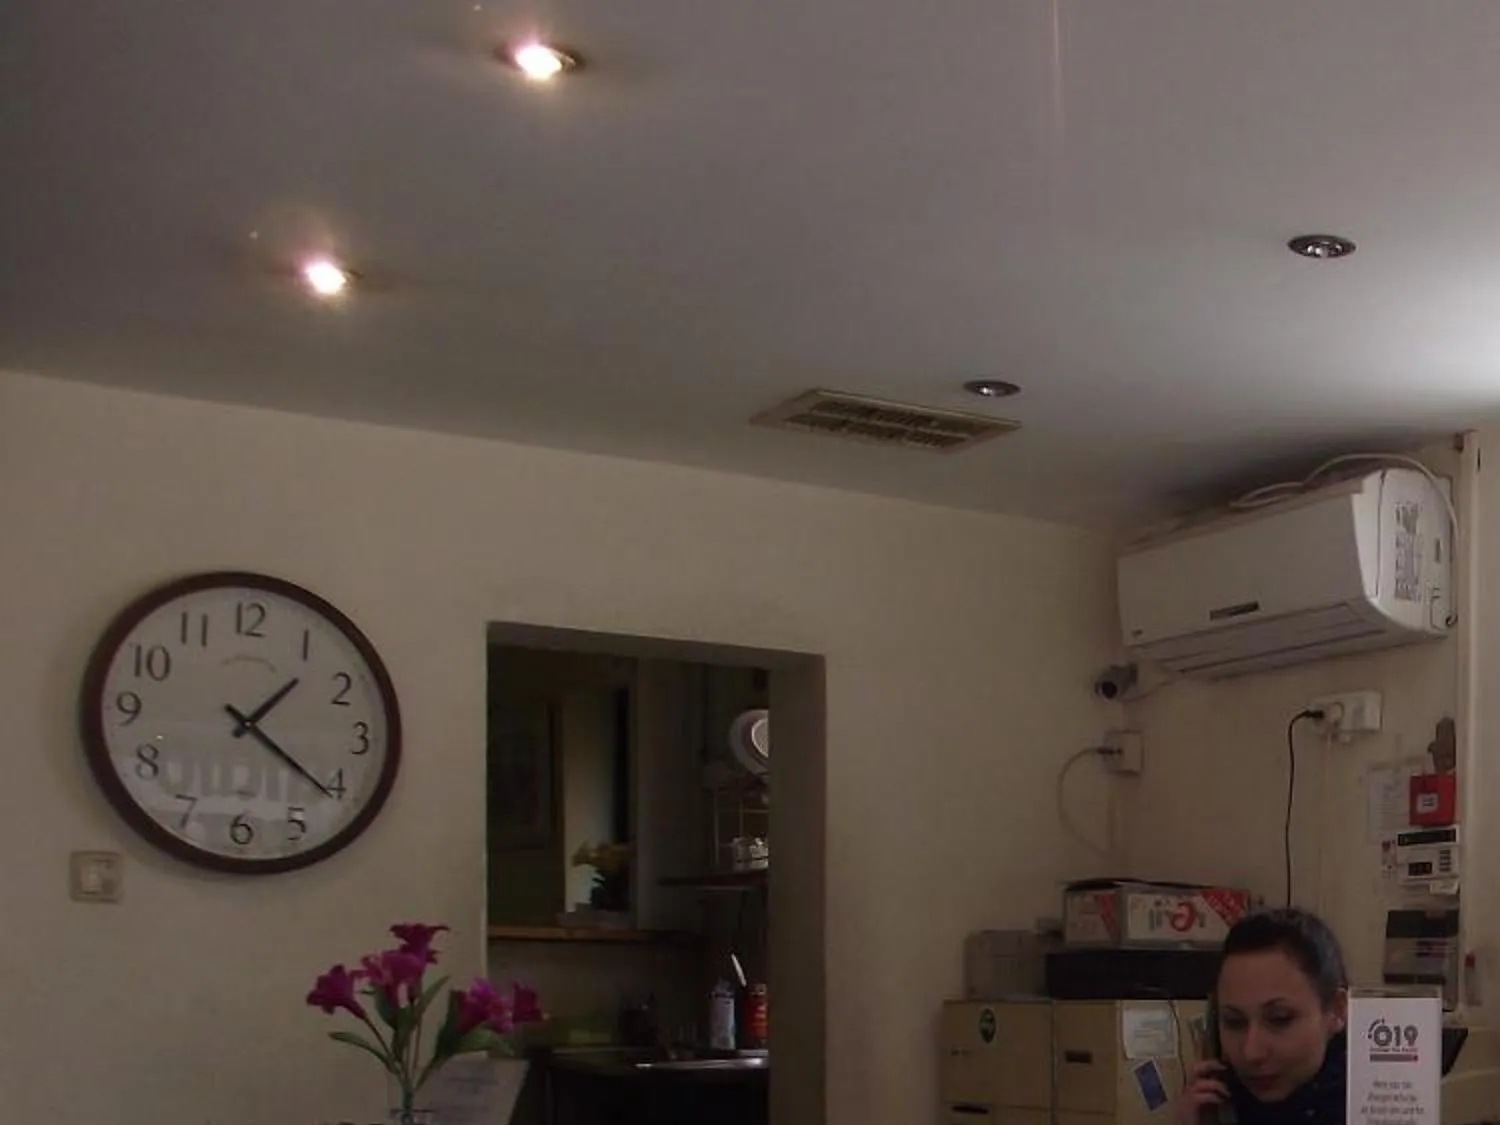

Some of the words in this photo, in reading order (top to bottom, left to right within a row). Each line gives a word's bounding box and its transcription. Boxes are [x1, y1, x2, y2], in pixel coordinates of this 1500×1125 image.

[181, 611, 208, 648] 11
[235, 602, 267, 638] 12
[301, 628, 309, 662] 1
[133, 644, 171, 682] 10
[331, 672, 352, 706] 2
[116, 691, 142, 726] 9
[351, 721, 370, 756] 3
[135, 743, 159, 780] 8
[325, 768, 346, 800] 4
[175, 793, 198, 828] 7
[287, 806, 307, 841] 5
[229, 813, 254, 846] 6
[1373, 1024, 1419, 1047] 019
